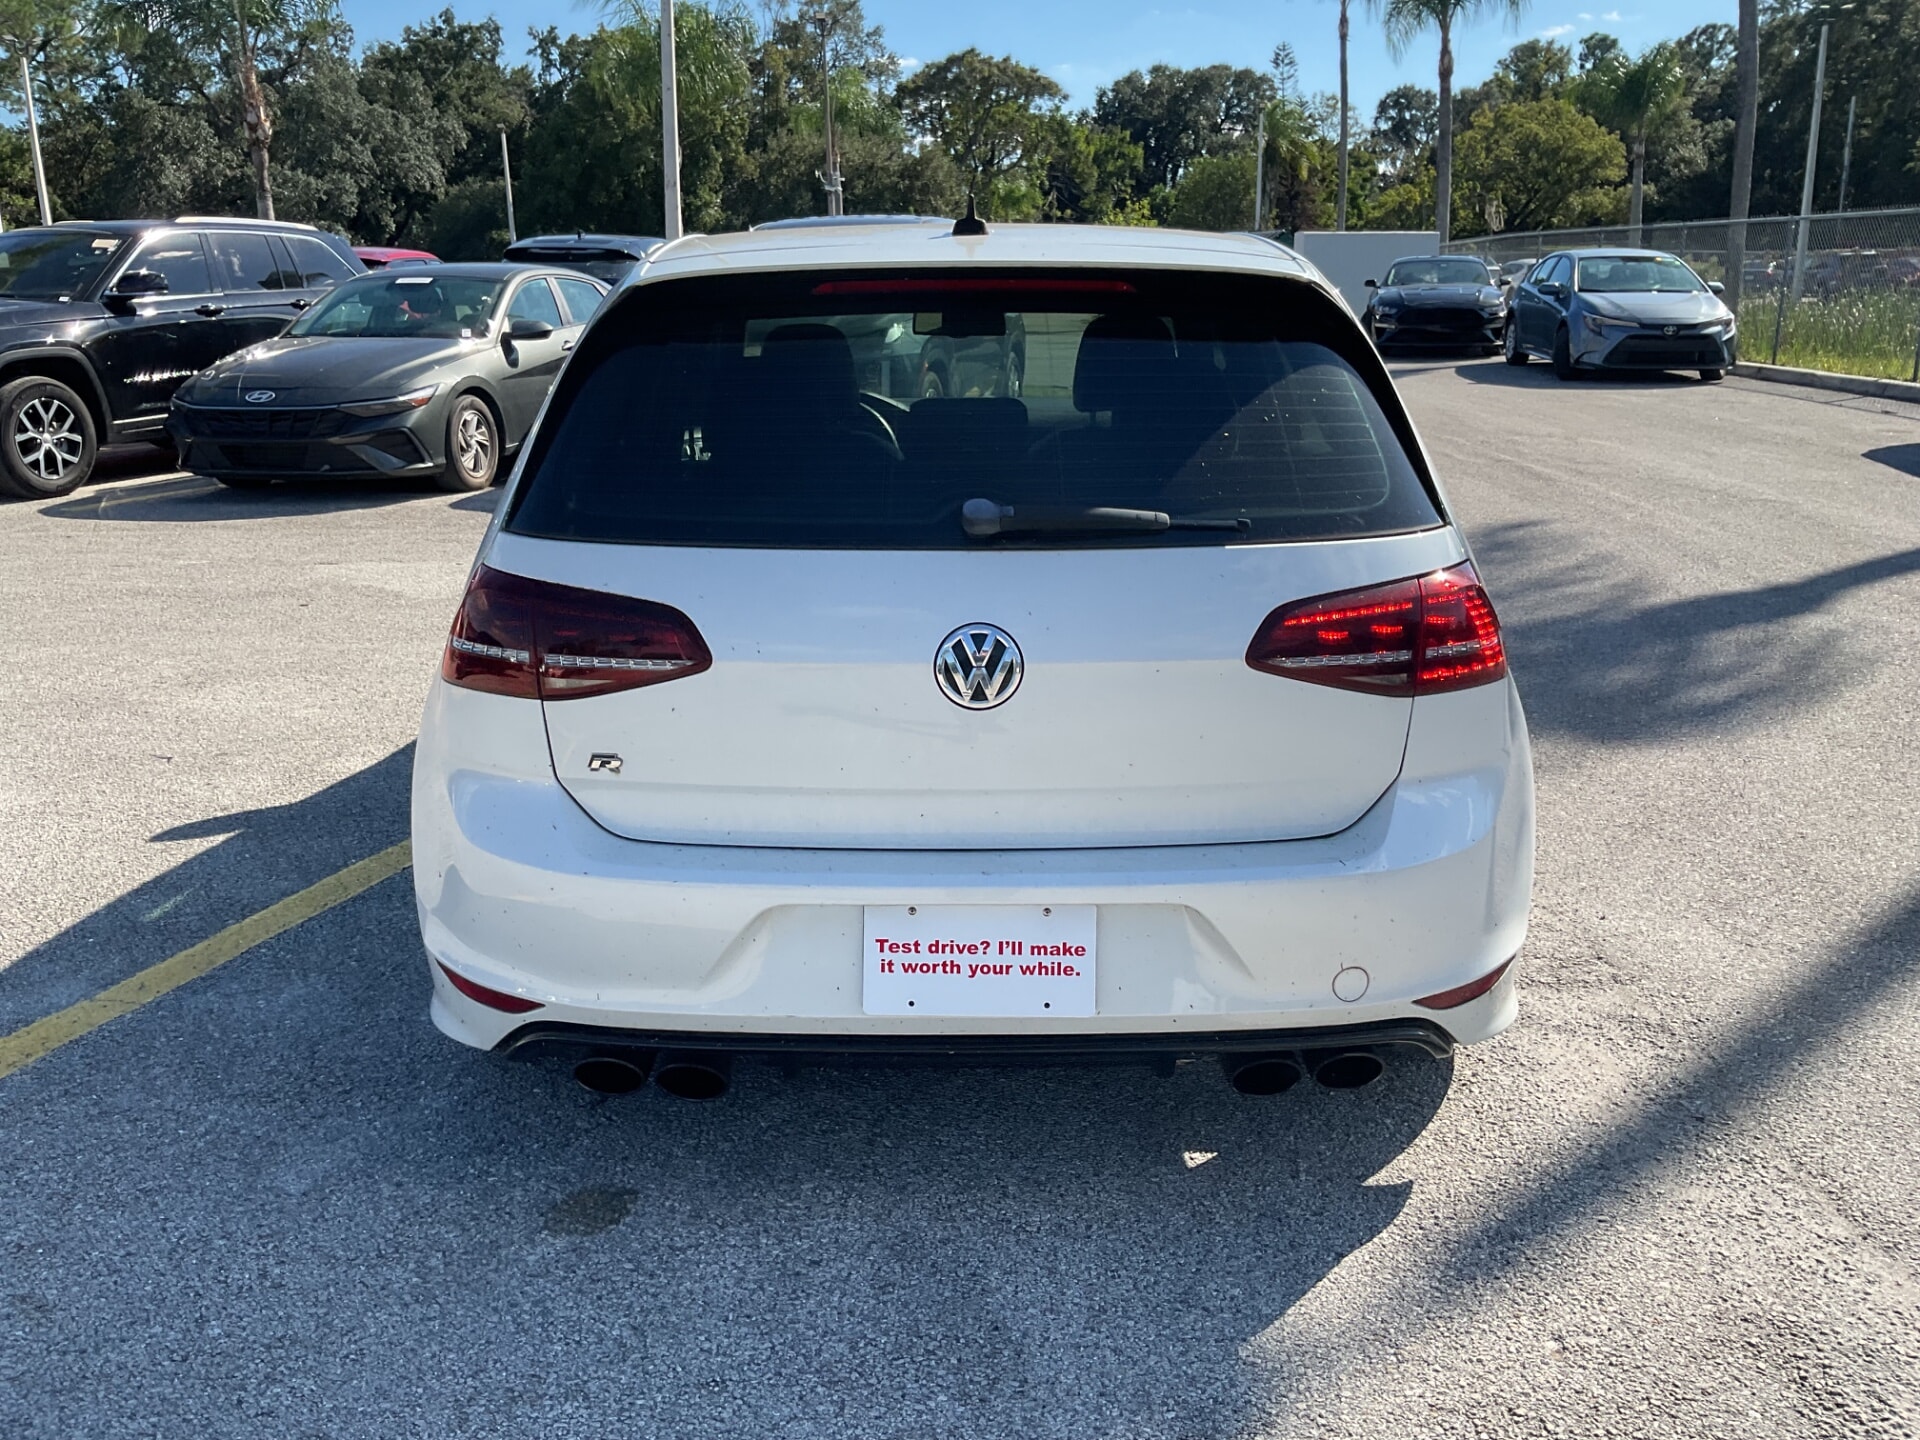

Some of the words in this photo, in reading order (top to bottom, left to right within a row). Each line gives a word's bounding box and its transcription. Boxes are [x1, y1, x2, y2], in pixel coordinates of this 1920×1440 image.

[935, 623, 1024, 710] VW
[588, 753, 623, 773] R
[875, 938, 921, 954] Test
[928, 940, 991, 955] drive?
[998, 941, 1023, 955] I’ll
[1030, 942, 1086, 956] make
[880, 959, 894, 973] it
[901, 959, 961, 974] worth
[968, 963, 1013, 978] your
[1019, 961, 1081, 976] while.
